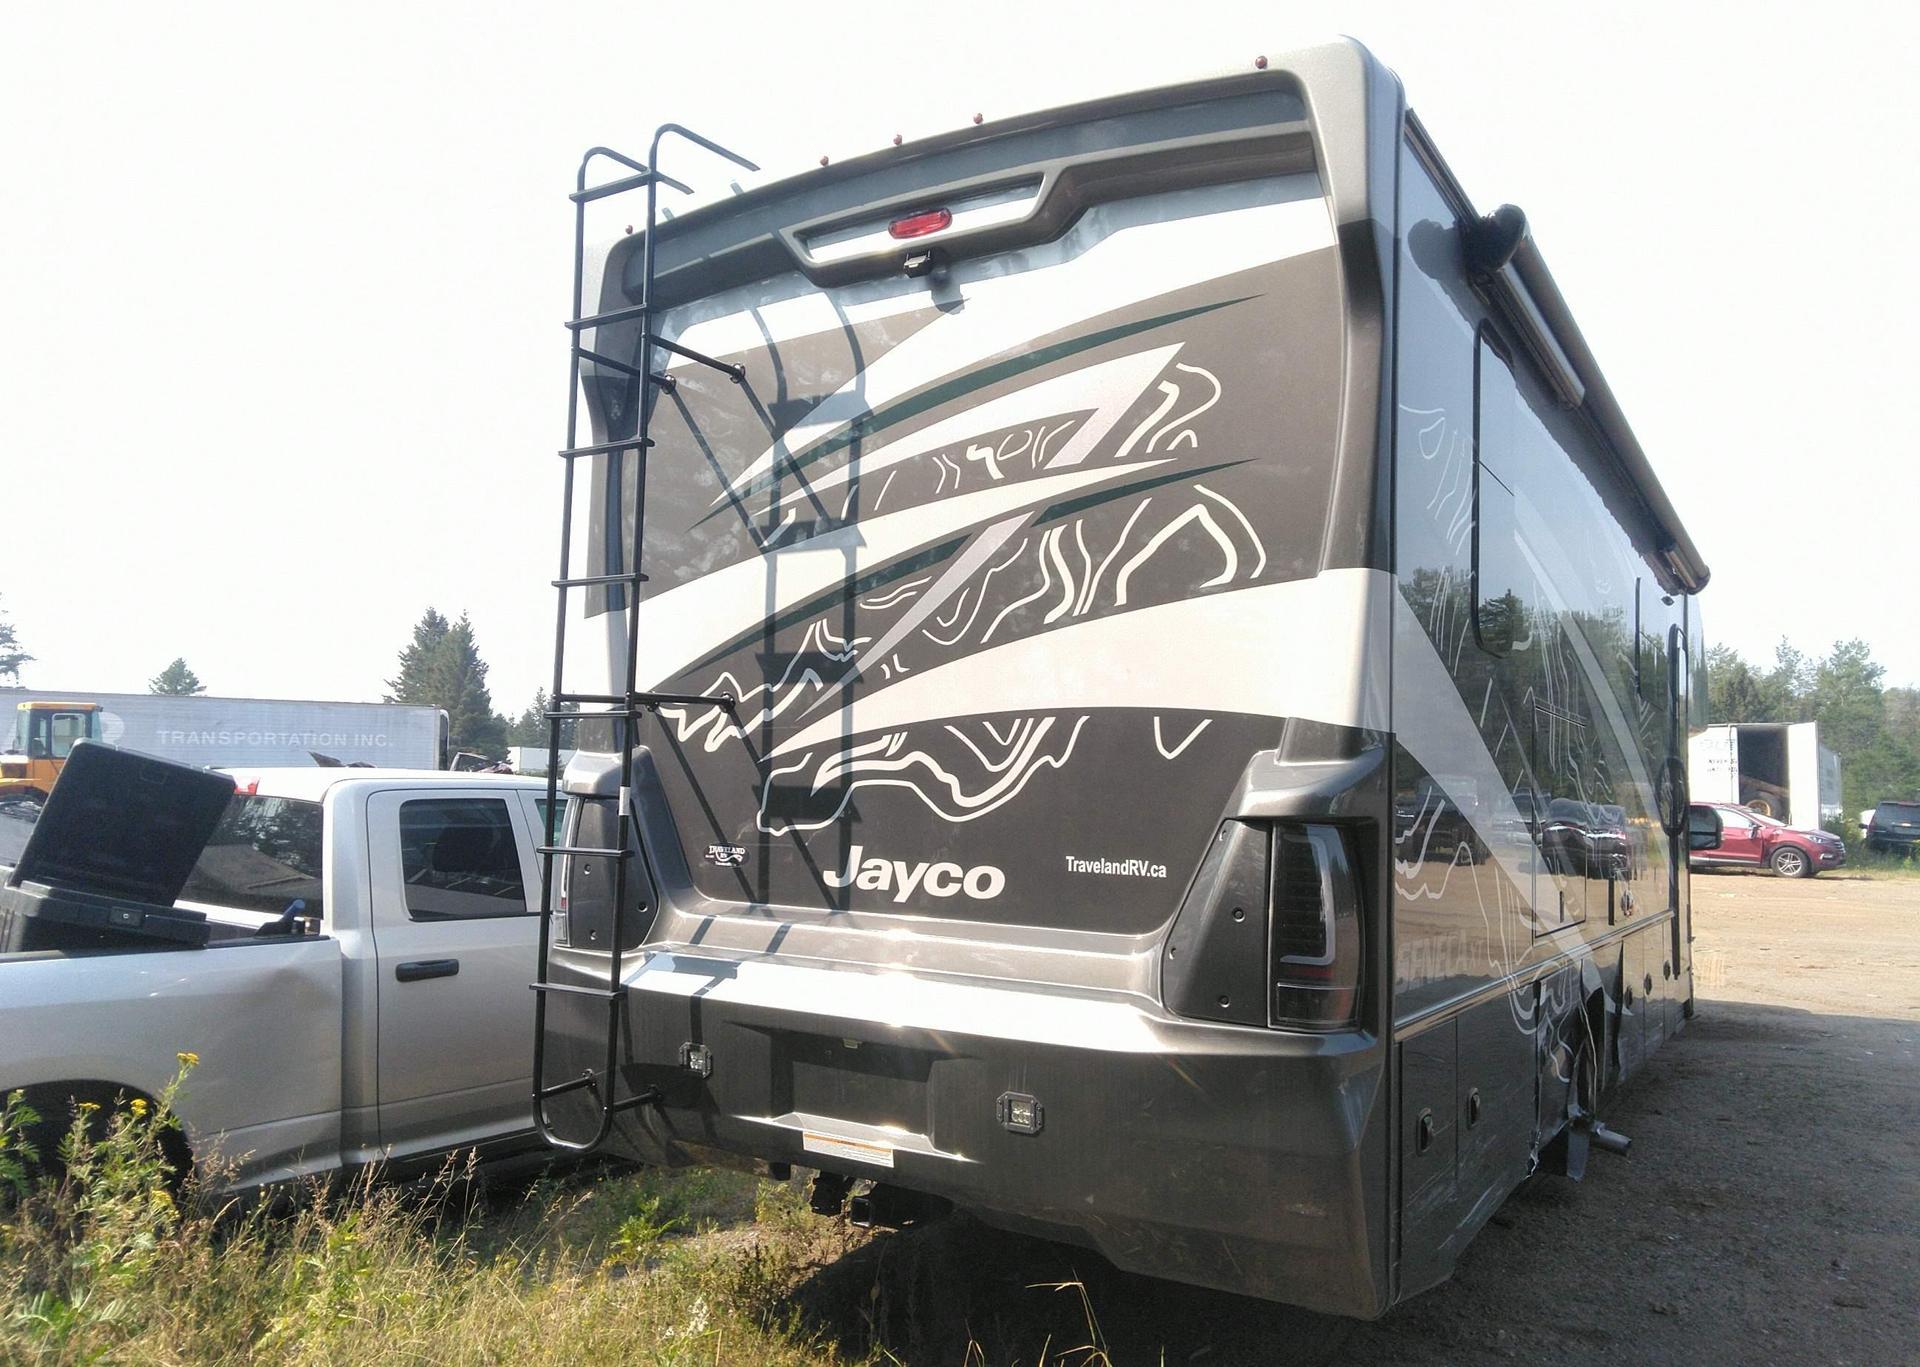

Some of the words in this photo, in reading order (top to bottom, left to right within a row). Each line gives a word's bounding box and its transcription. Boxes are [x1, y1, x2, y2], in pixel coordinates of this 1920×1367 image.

[156, 730, 347, 746] TRANSPORTATION
[354, 733, 393, 747] INC.
[823, 845, 1006, 903] Jayco
[1065, 855, 1167, 878] TravelandRV.ca
